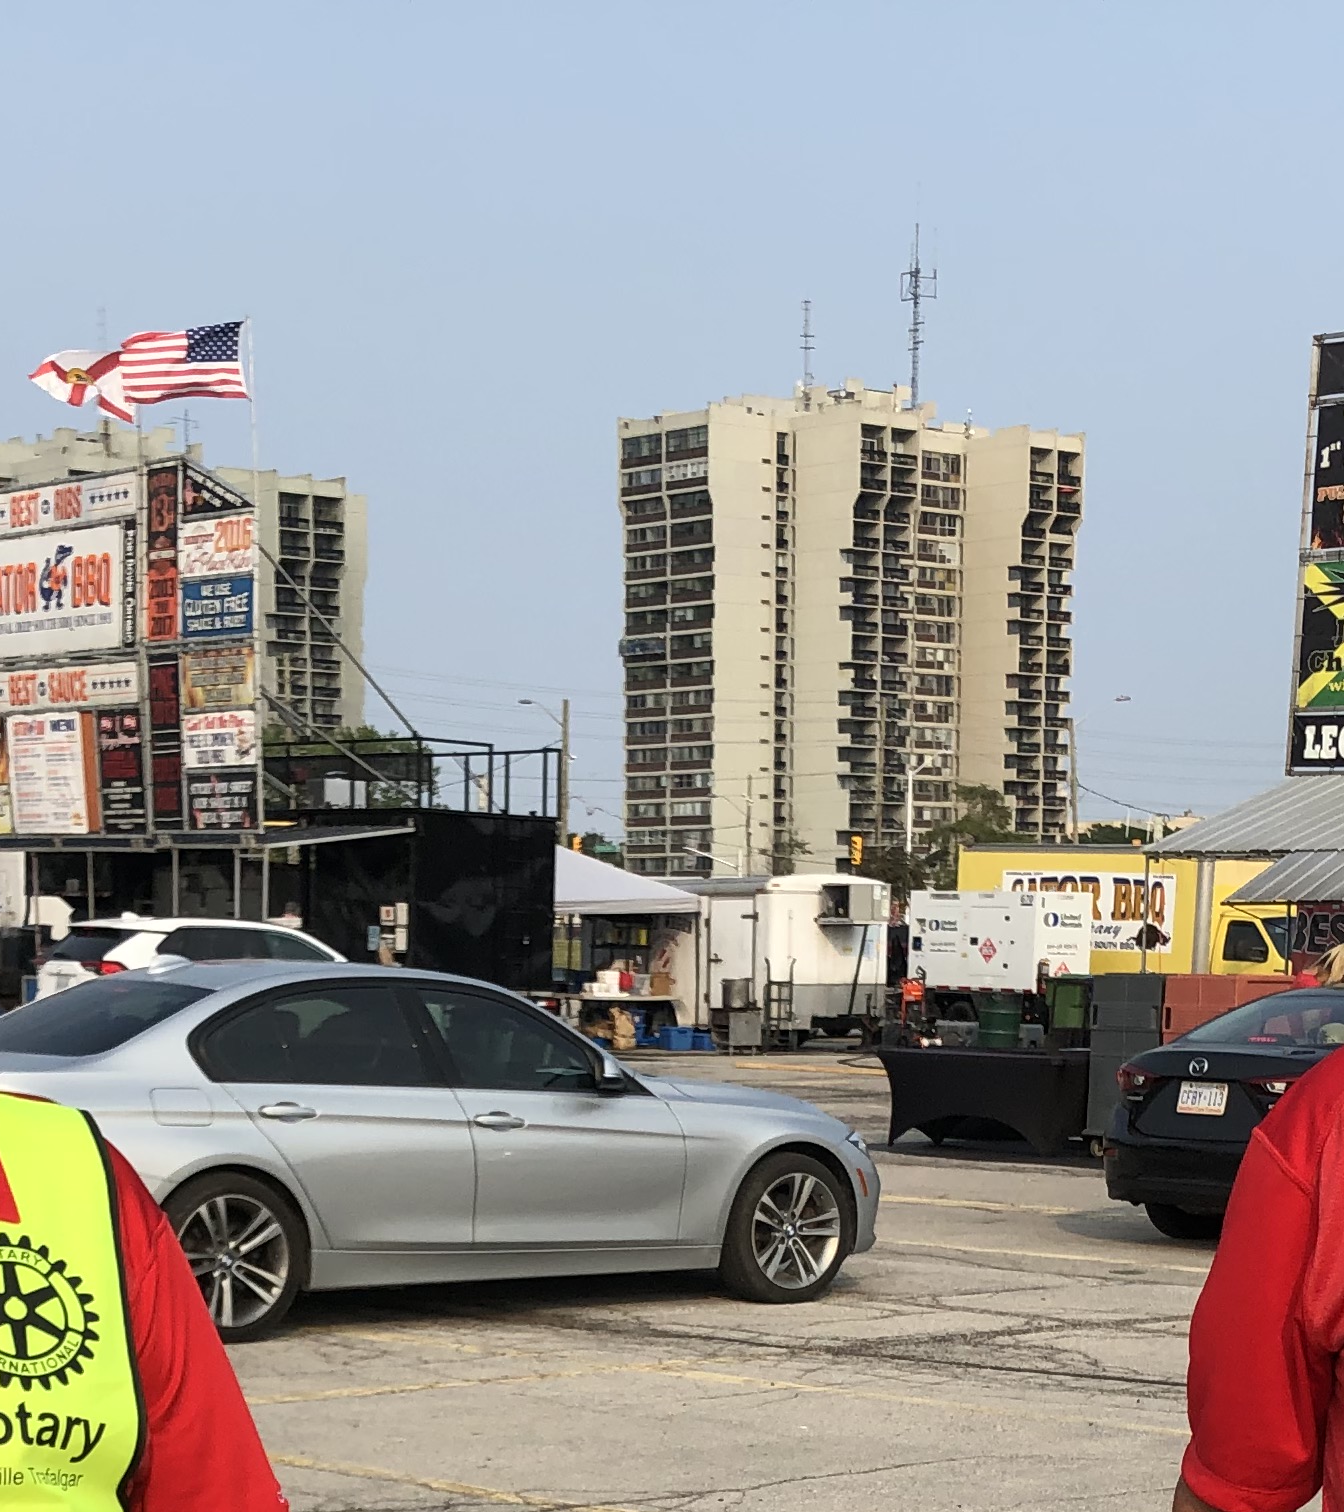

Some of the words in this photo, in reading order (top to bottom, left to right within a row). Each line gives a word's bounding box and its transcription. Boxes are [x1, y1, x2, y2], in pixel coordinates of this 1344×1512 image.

[1320, 441, 1341, 468] 1st
[9, 492, 41, 528] BEST
[71, 552, 112, 608] BBQ
[8, 673, 39, 706] BEST
[47, 670, 89, 703] SAUCE
[1111, 877, 1166, 927] BBQ
